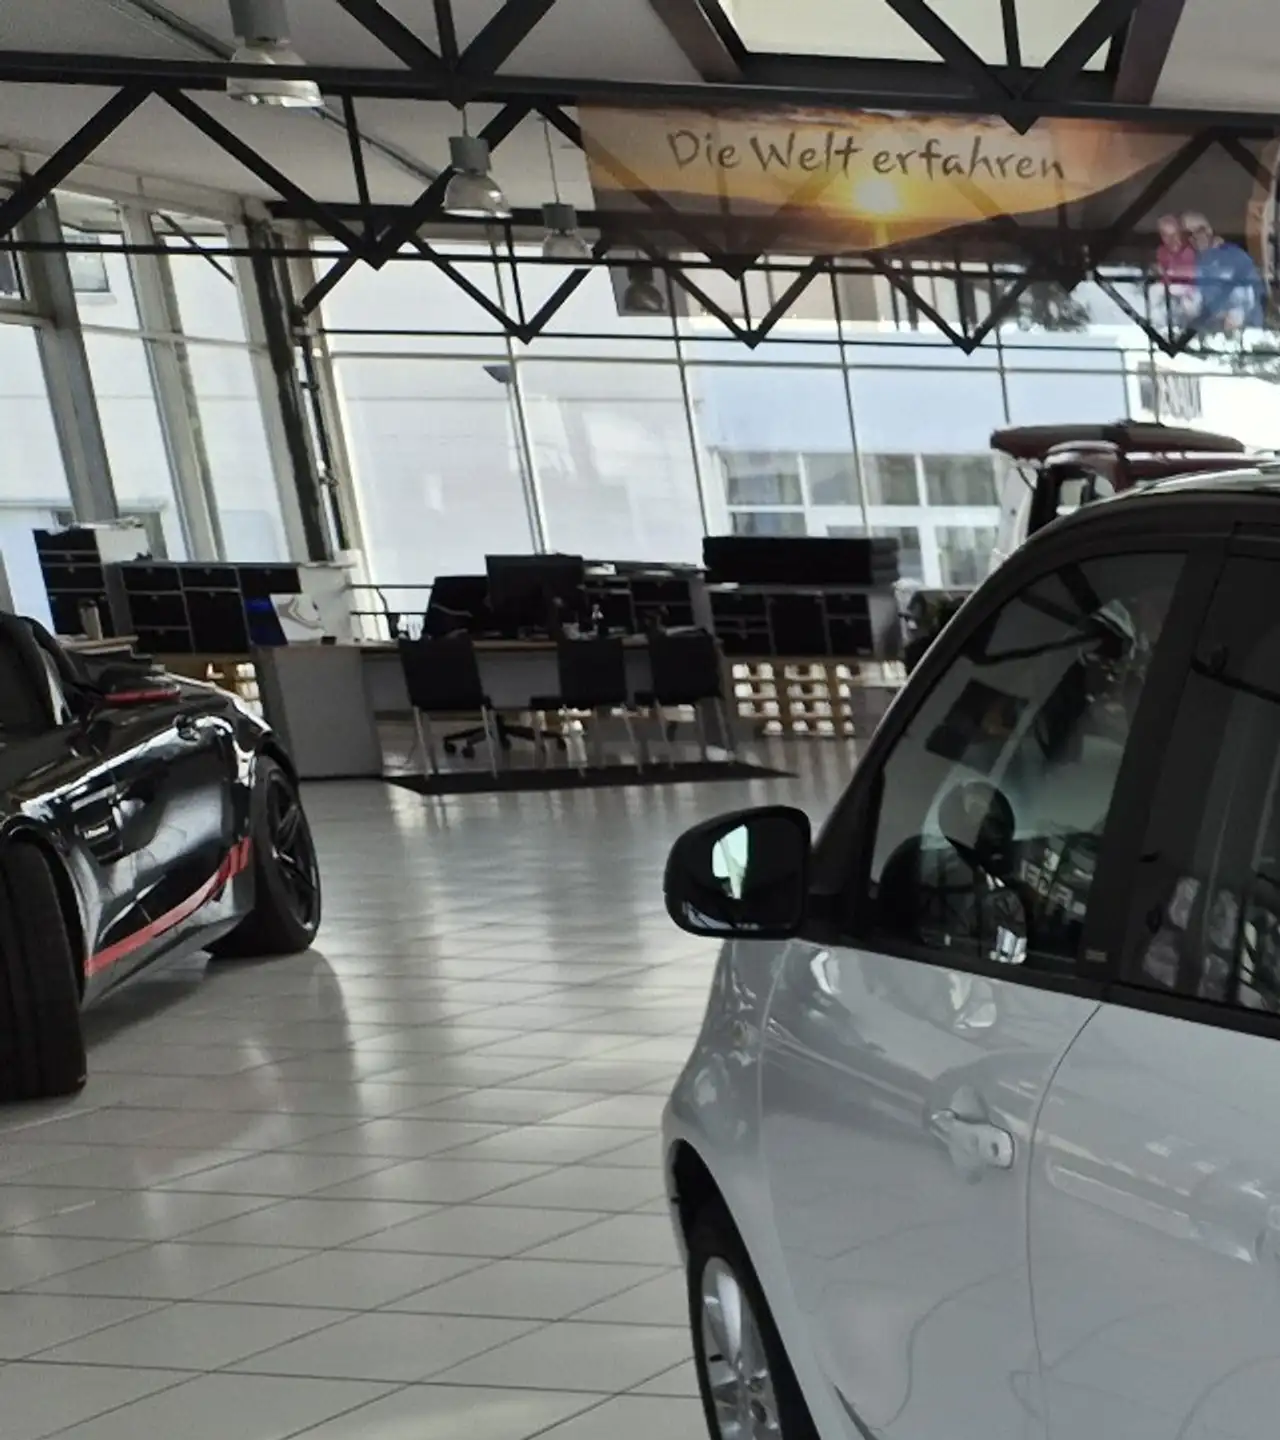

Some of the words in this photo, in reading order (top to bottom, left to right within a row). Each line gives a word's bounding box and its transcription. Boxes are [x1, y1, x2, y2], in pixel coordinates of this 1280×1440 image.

[667, 129, 742, 170] Die
[749, 131, 860, 177] Welt
[873, 138, 1066, 182] erfahren
